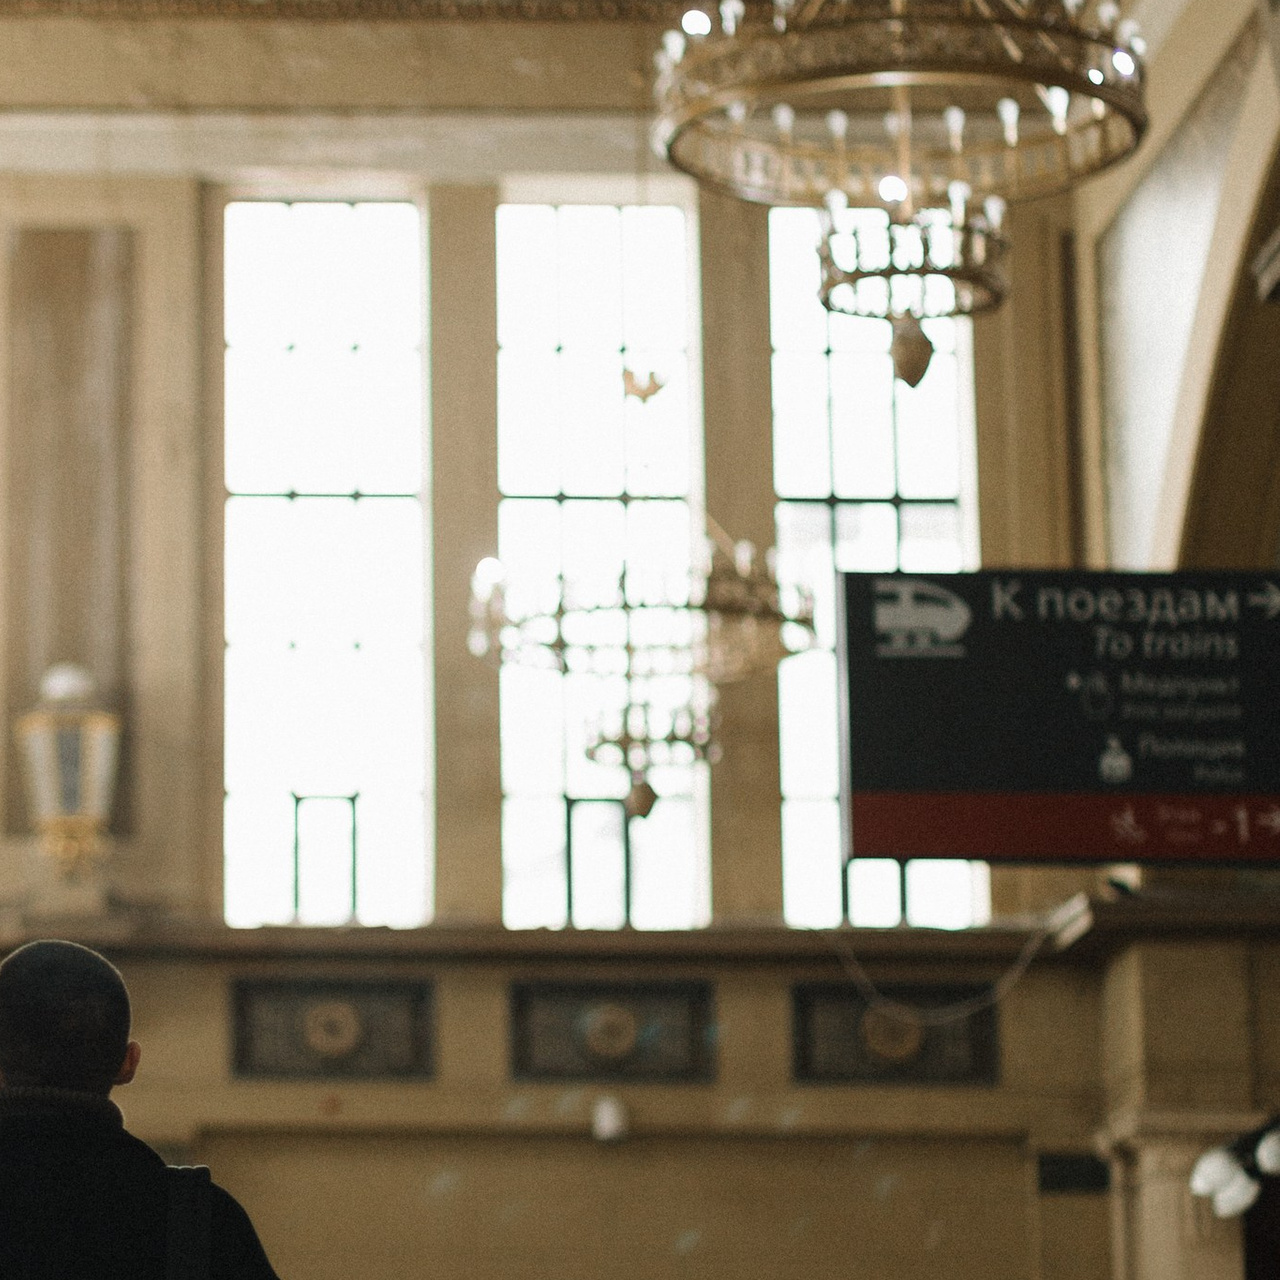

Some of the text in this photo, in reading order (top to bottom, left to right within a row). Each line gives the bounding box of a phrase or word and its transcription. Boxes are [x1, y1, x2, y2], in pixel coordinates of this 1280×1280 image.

[991, 577, 1240, 627] К поездам
[1094, 625, 1239, 660] To trains
